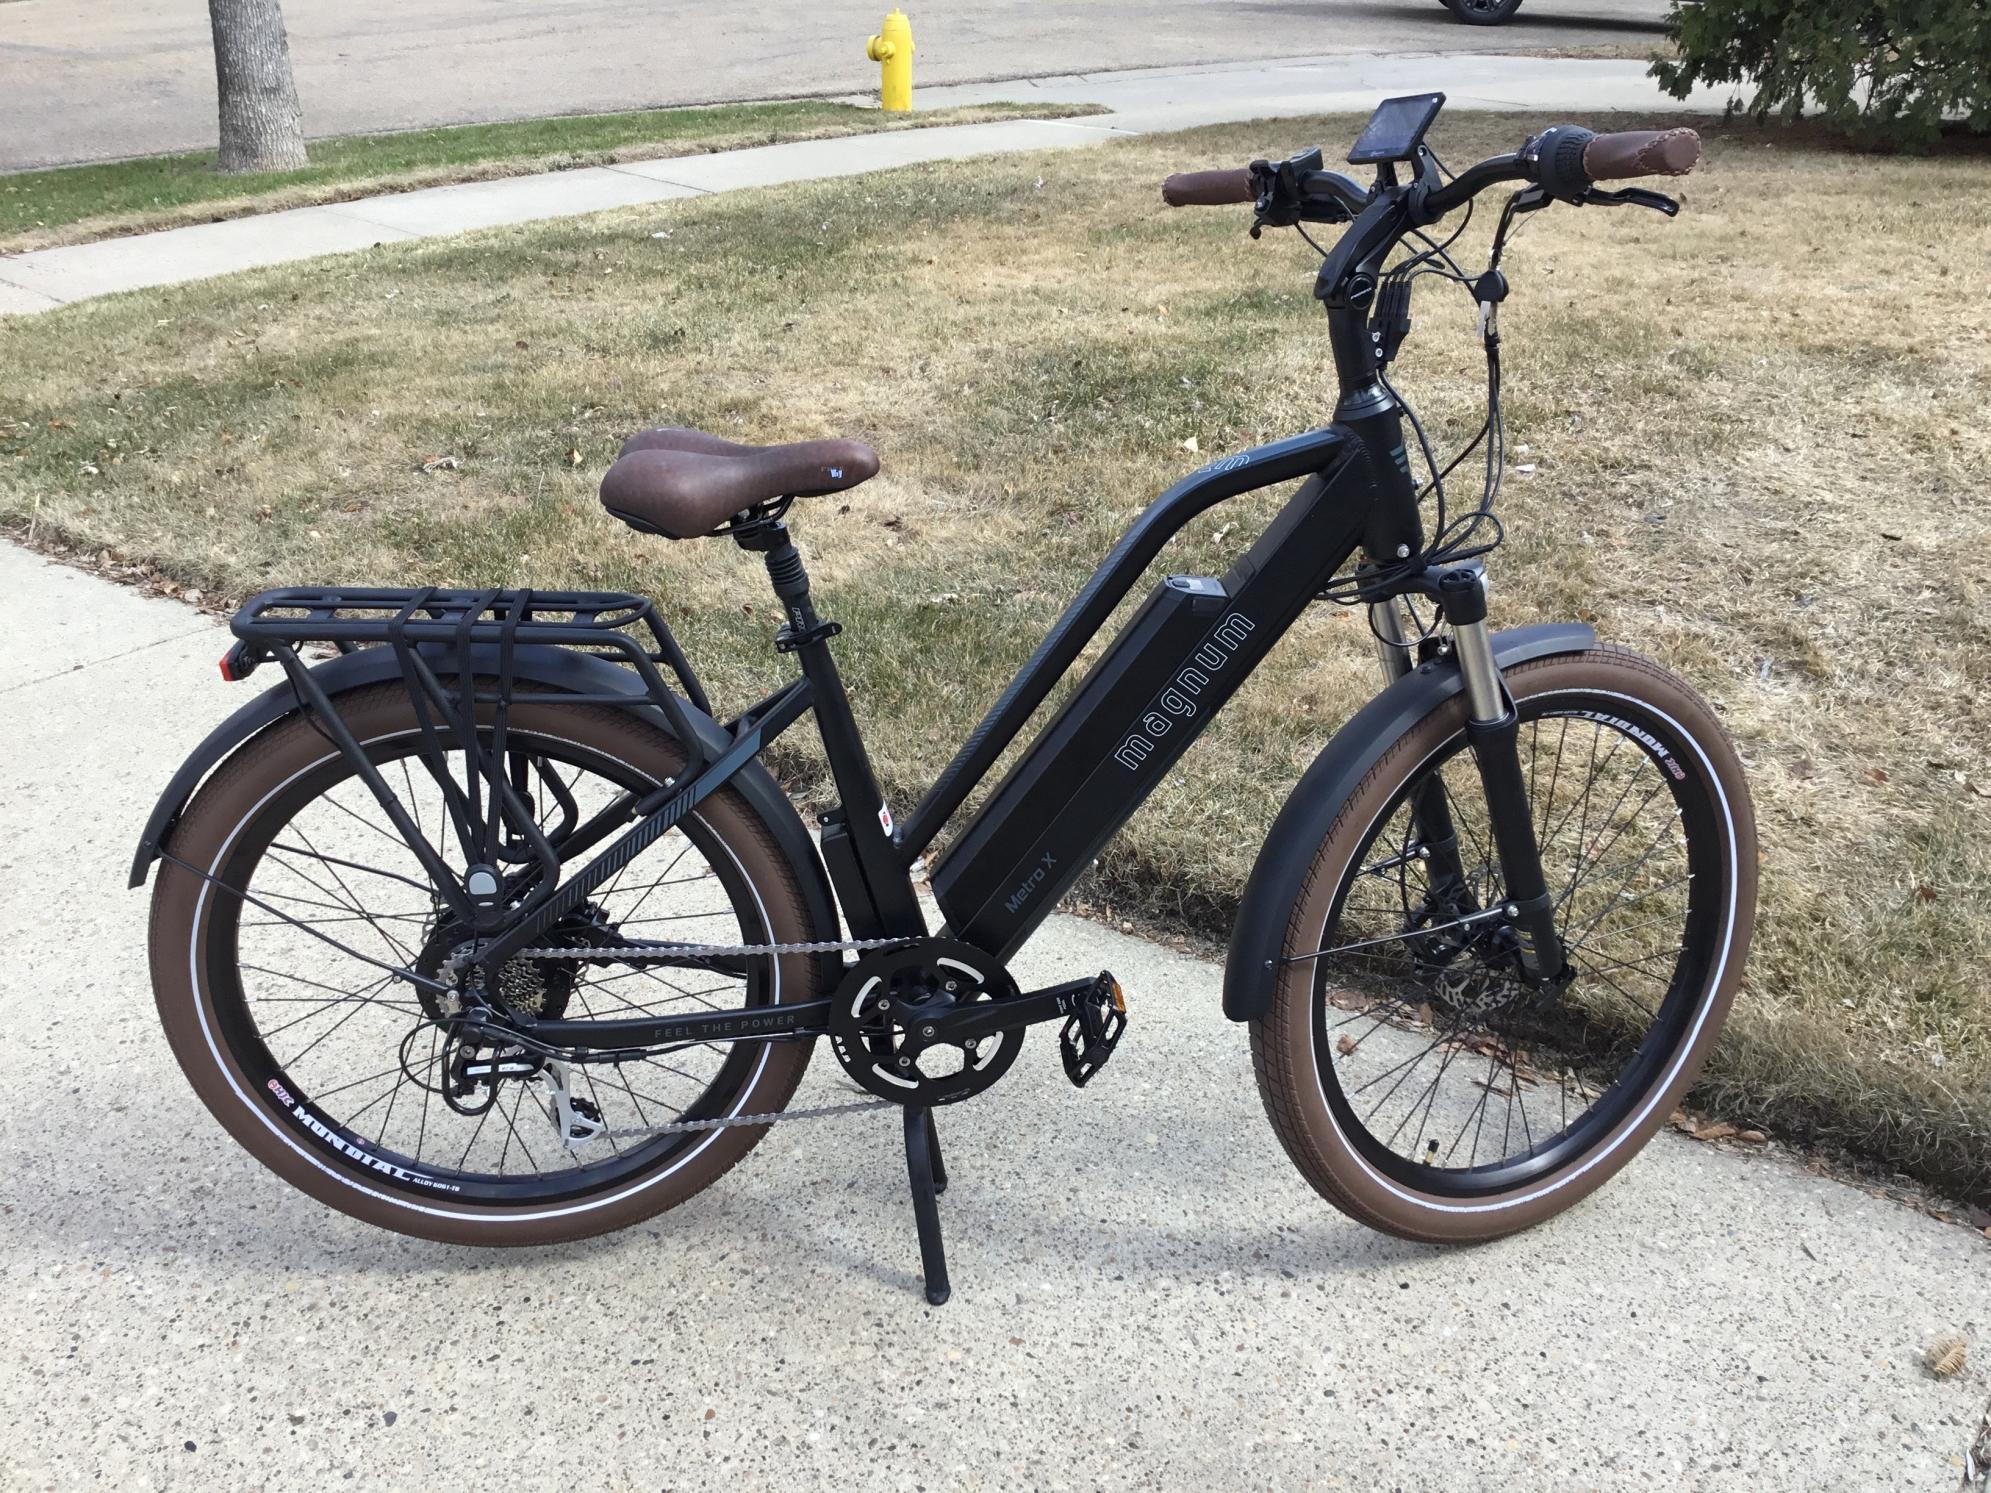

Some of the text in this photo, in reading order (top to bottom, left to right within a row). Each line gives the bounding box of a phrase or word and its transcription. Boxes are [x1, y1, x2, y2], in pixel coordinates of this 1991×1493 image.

[1114, 612, 1256, 771] magnum
[1581, 710, 1670, 758] MUNDIAL
[1004, 851, 1057, 913] Metro X
[655, 1015, 795, 1038] FEEL THE POWER
[292, 1105, 431, 1181] MUNDIAL
